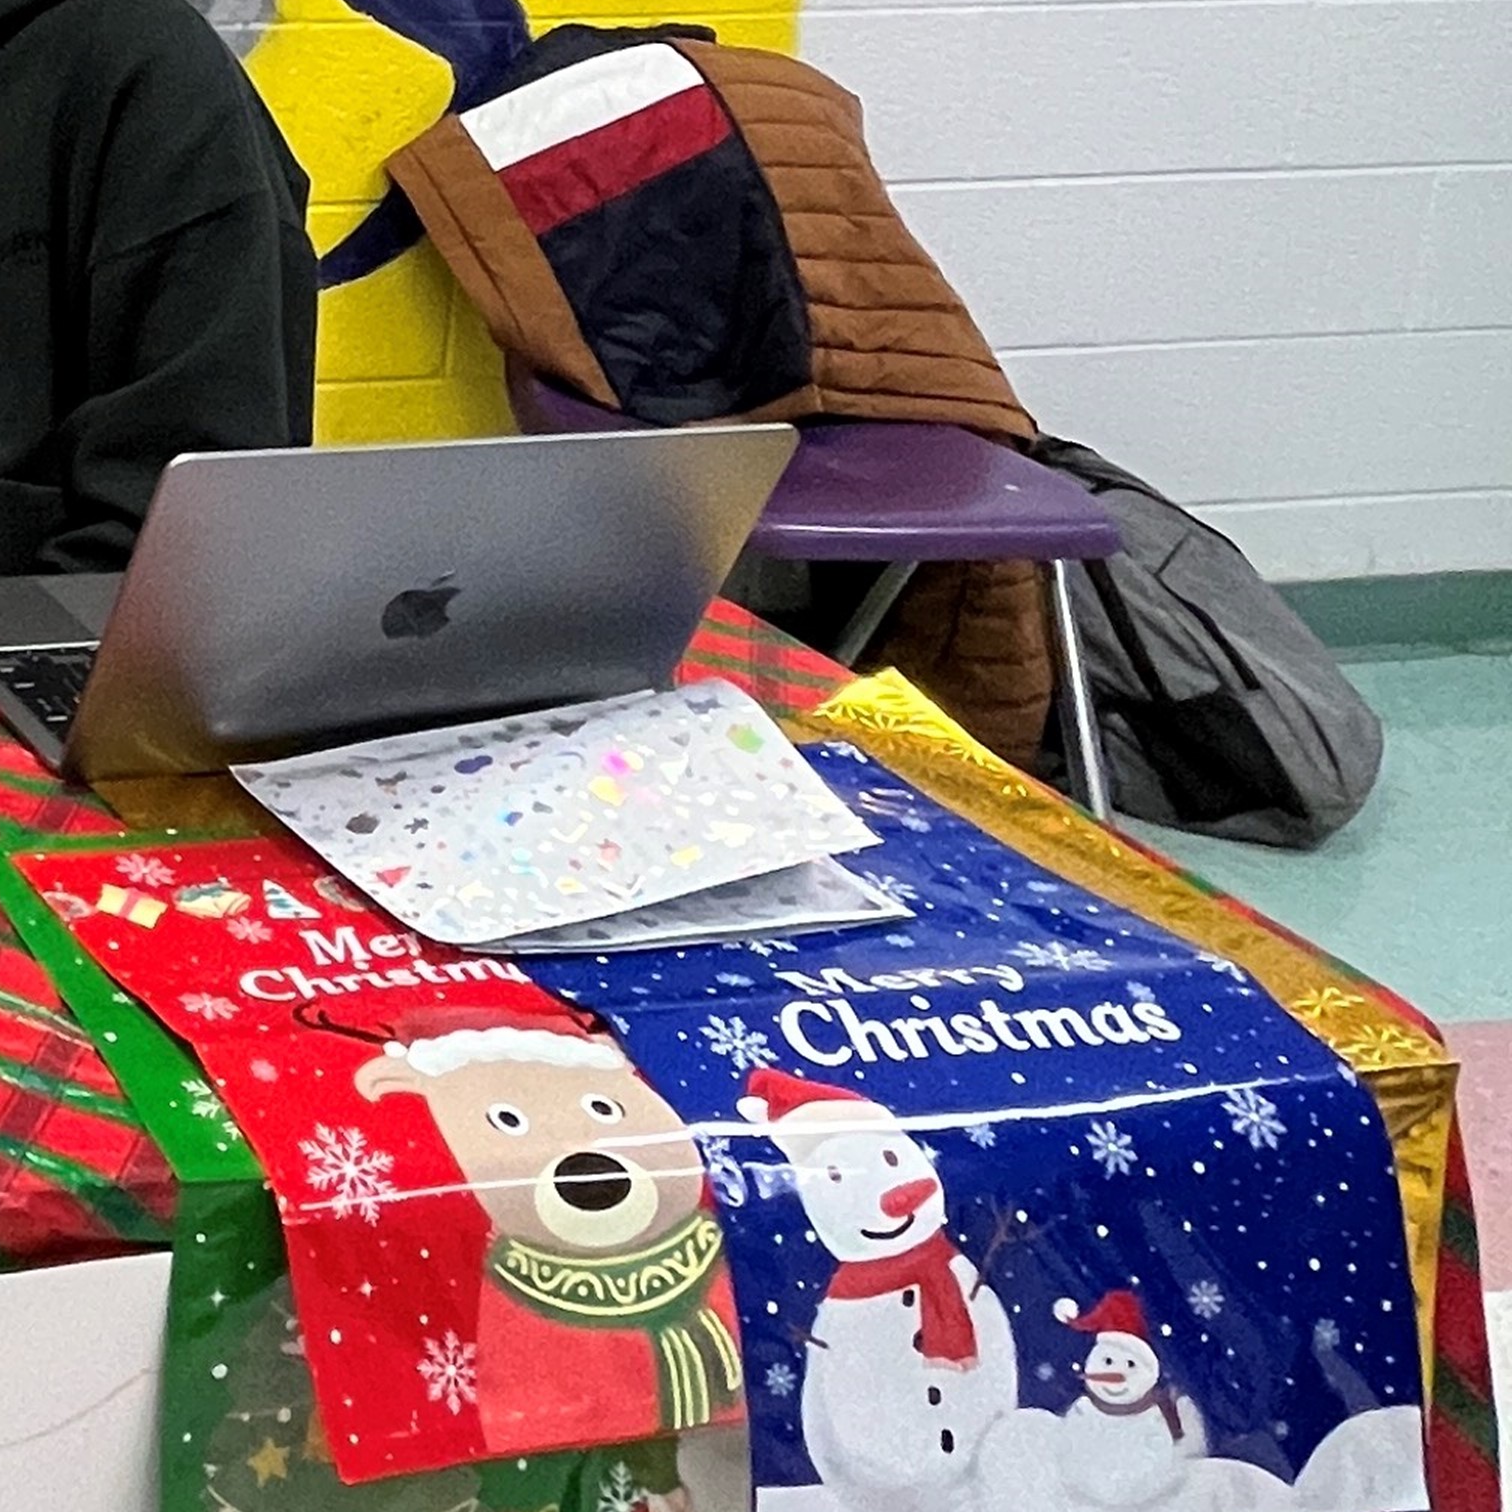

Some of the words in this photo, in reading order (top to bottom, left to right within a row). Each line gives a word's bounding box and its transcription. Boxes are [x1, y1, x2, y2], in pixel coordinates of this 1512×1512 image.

[297, 925, 422, 966] Mer
[238, 957, 534, 1001] Christm
[775, 963, 1026, 996] Merry
[780, 994, 1182, 1067] Christmas
